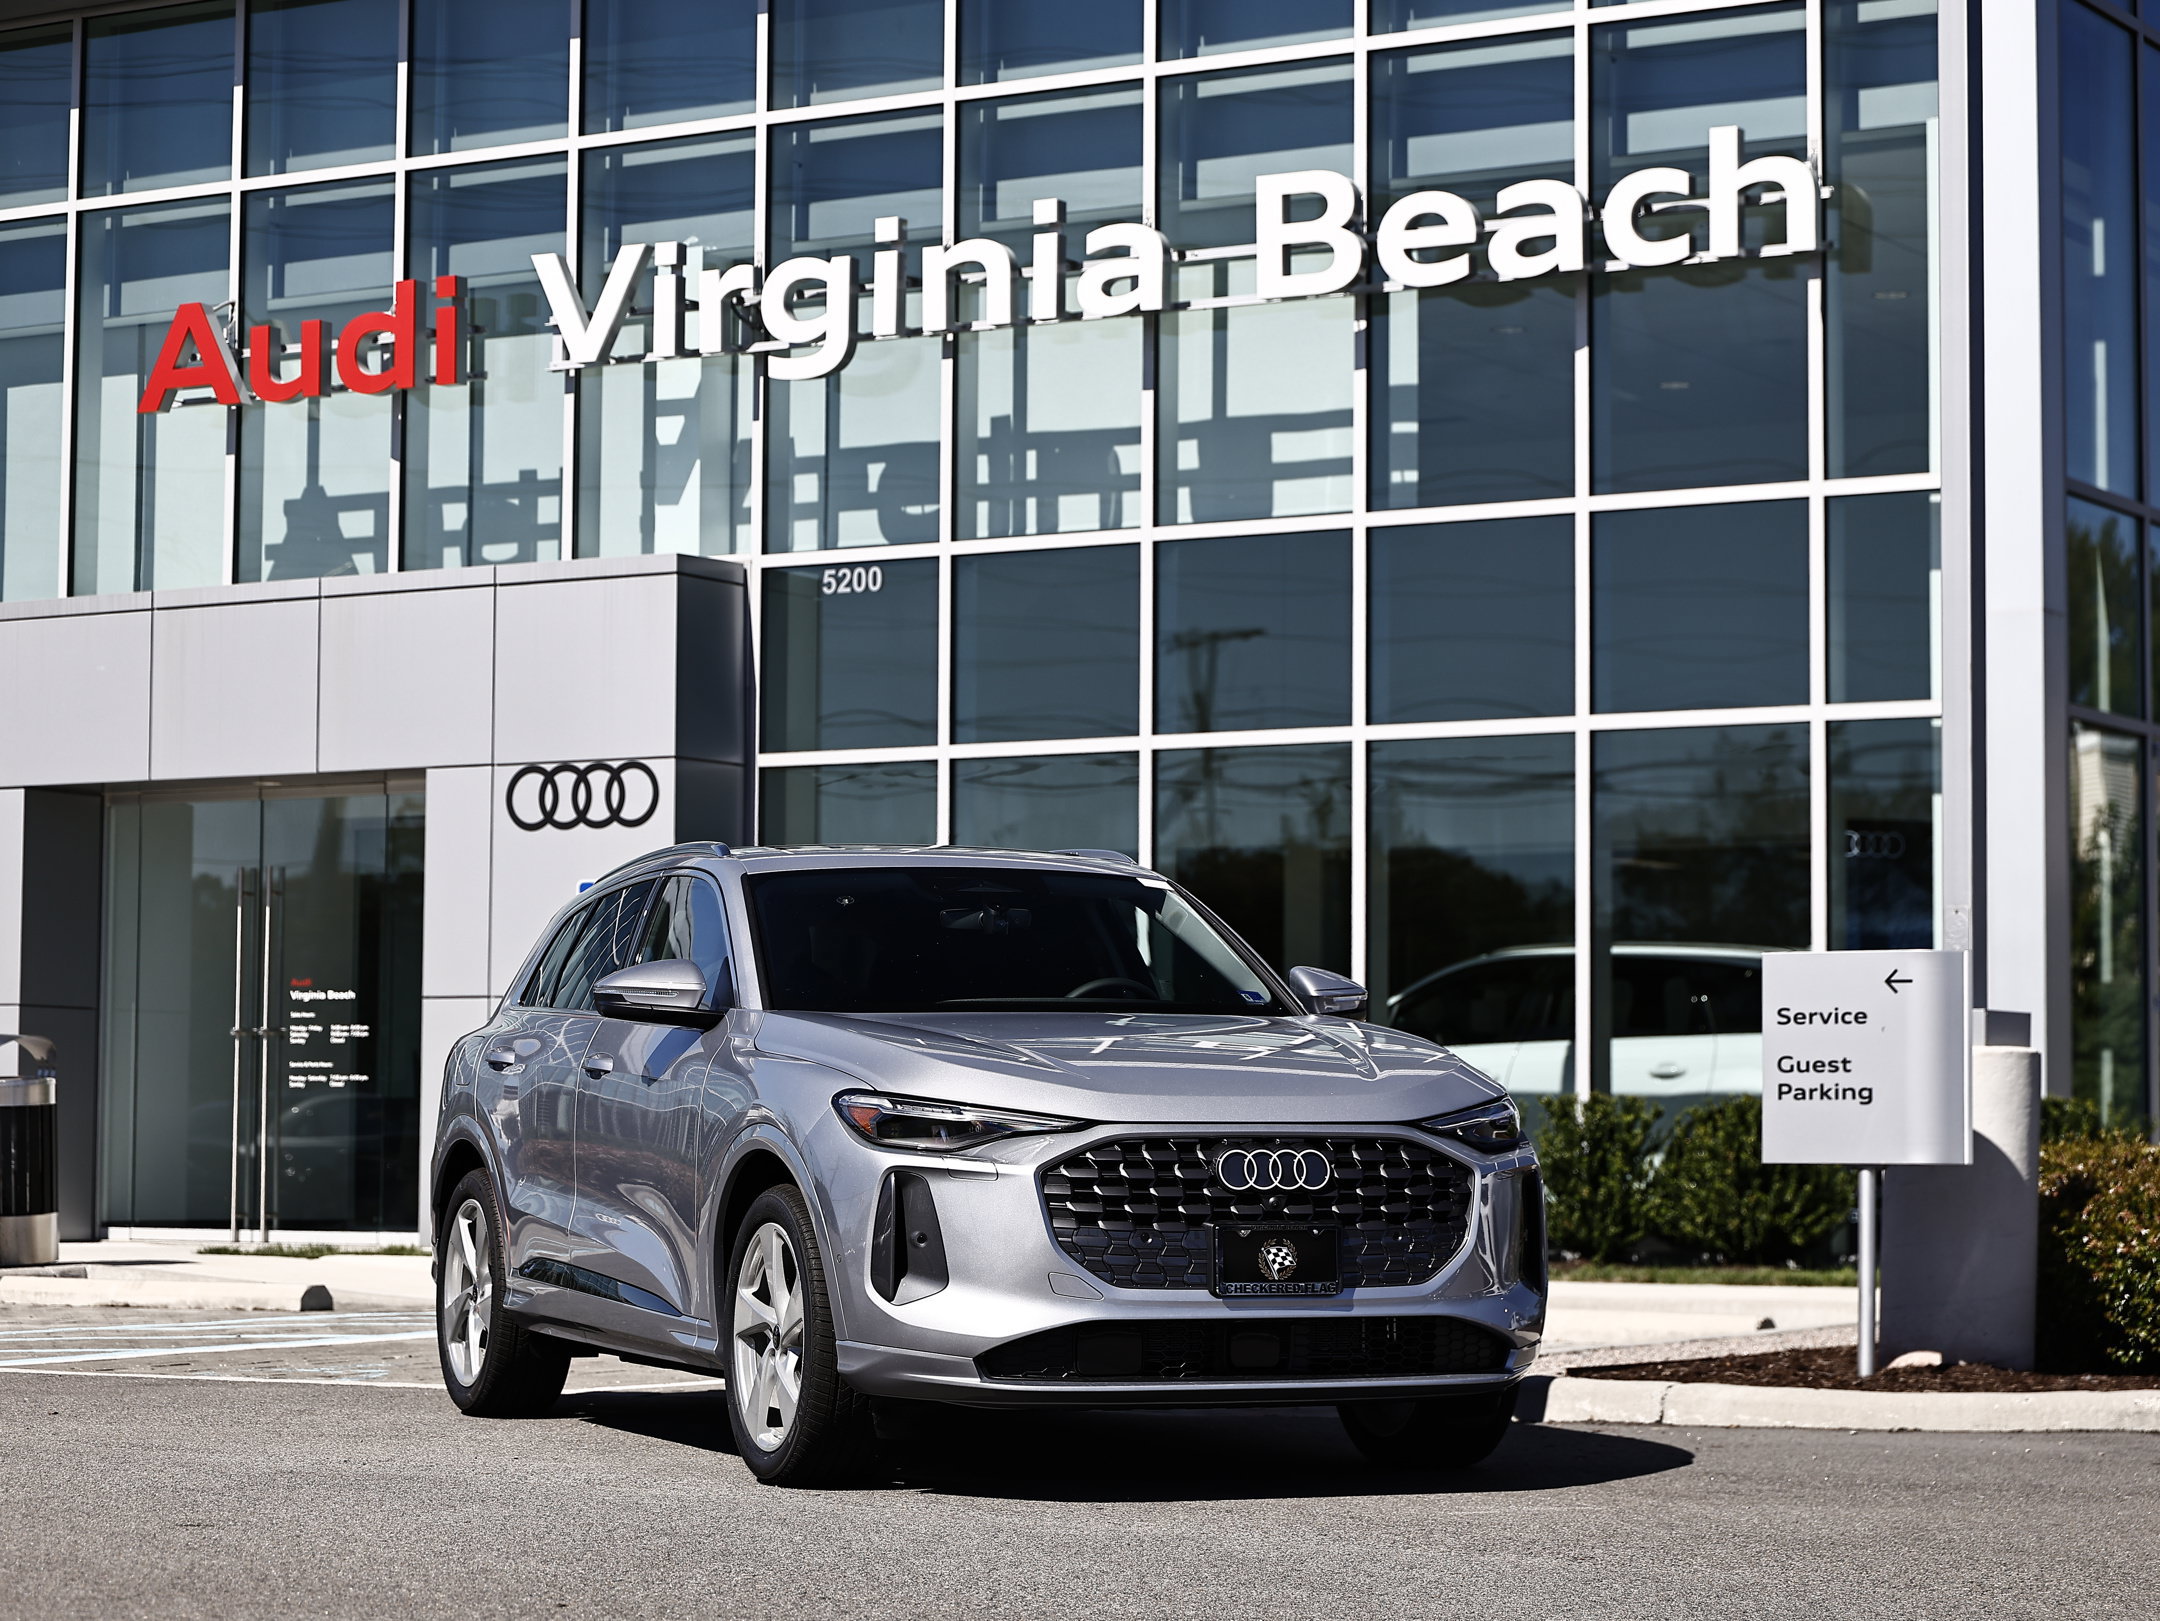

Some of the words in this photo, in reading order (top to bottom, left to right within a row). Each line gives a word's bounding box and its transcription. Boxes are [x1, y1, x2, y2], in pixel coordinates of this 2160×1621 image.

[137, 275, 466, 413] Audi
[531, 198, 1172, 380] Virginia
[1256, 125, 1821, 300] Beach
[822, 565, 883, 595] 5200
[290, 990, 326, 1002] Virginia
[1776, 1007, 1868, 1026] Service
[1776, 1055, 1853, 1074] Guest
[1777, 1083, 1874, 1106] Parking
[1225, 1283, 1300, 1294] CHECKERED
[1305, 1283, 1336, 1294] FLAG
